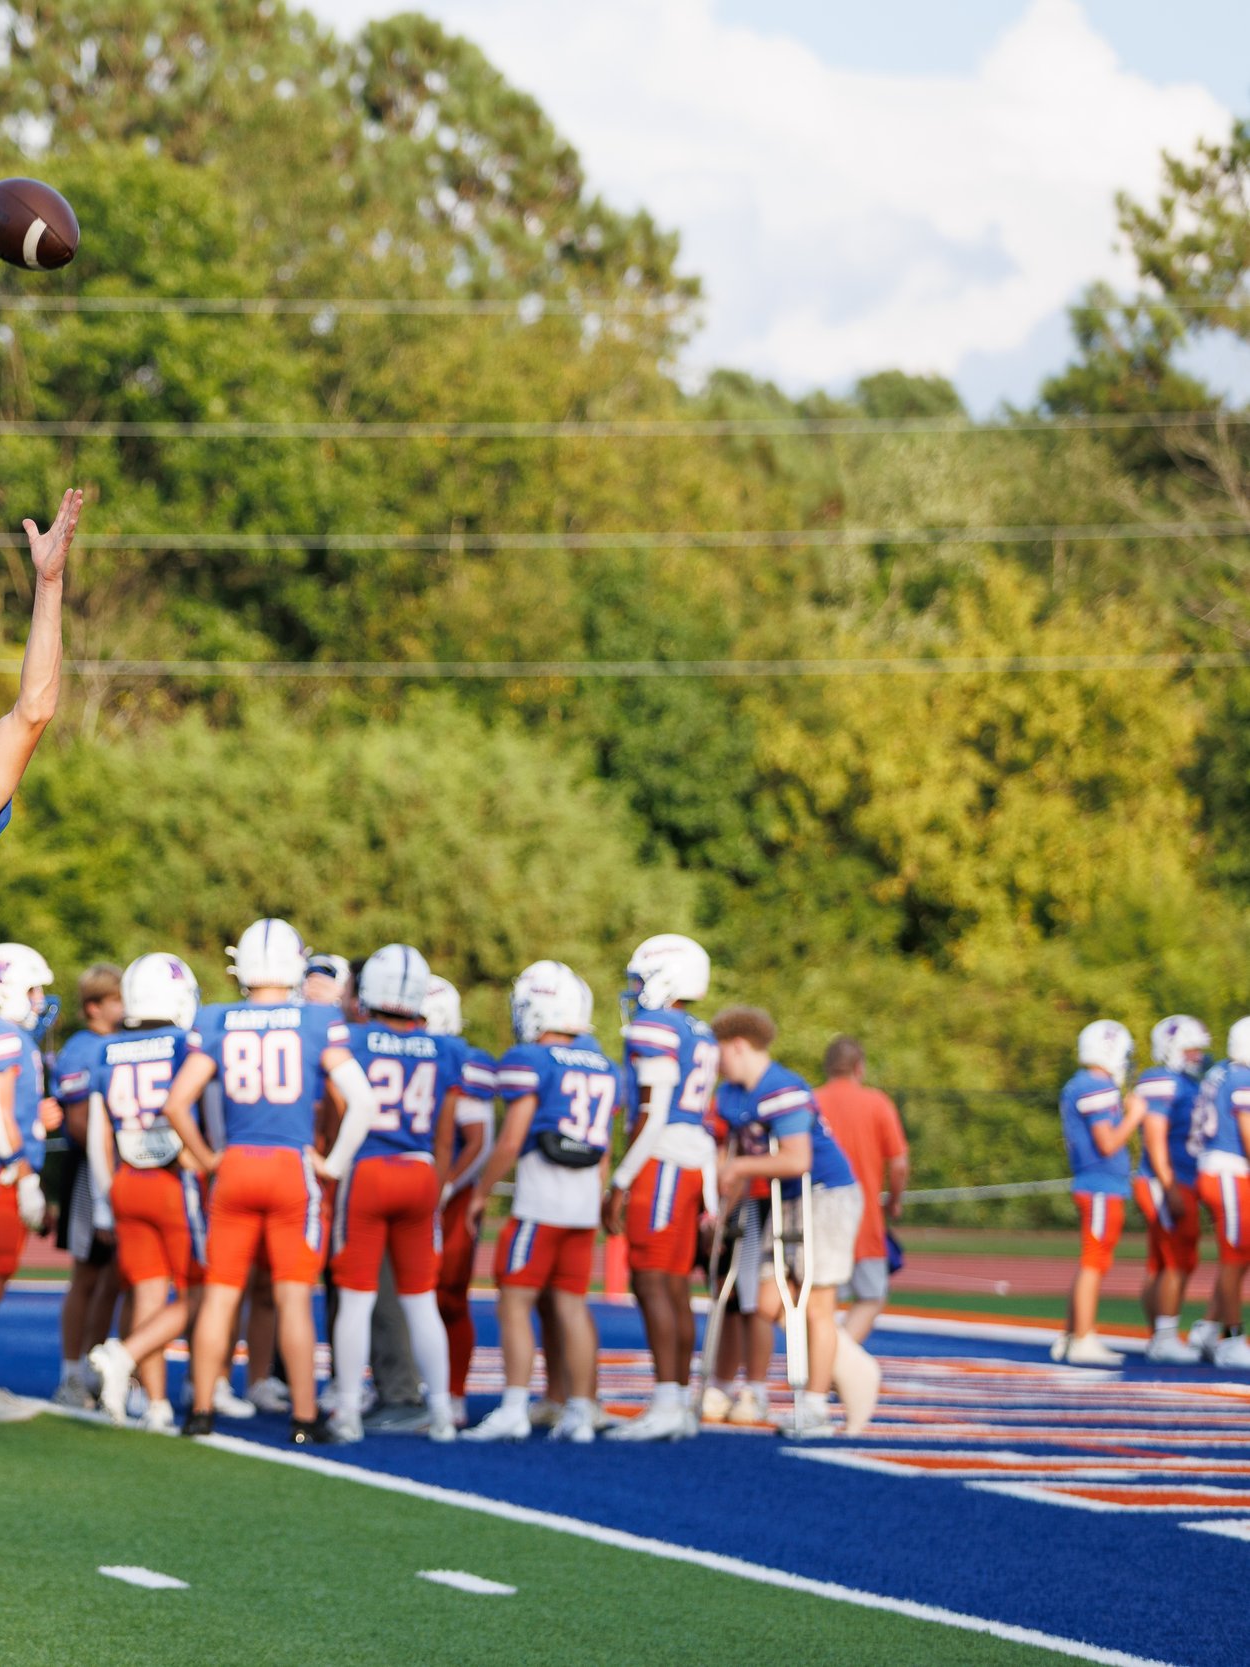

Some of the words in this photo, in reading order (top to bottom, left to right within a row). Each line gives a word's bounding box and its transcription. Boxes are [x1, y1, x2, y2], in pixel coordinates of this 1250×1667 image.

[108, 1061, 172, 1130] 45
[223, 1029, 302, 1104] 80
[368, 1057, 437, 1133] 24
[558, 1071, 616, 1147] 37
